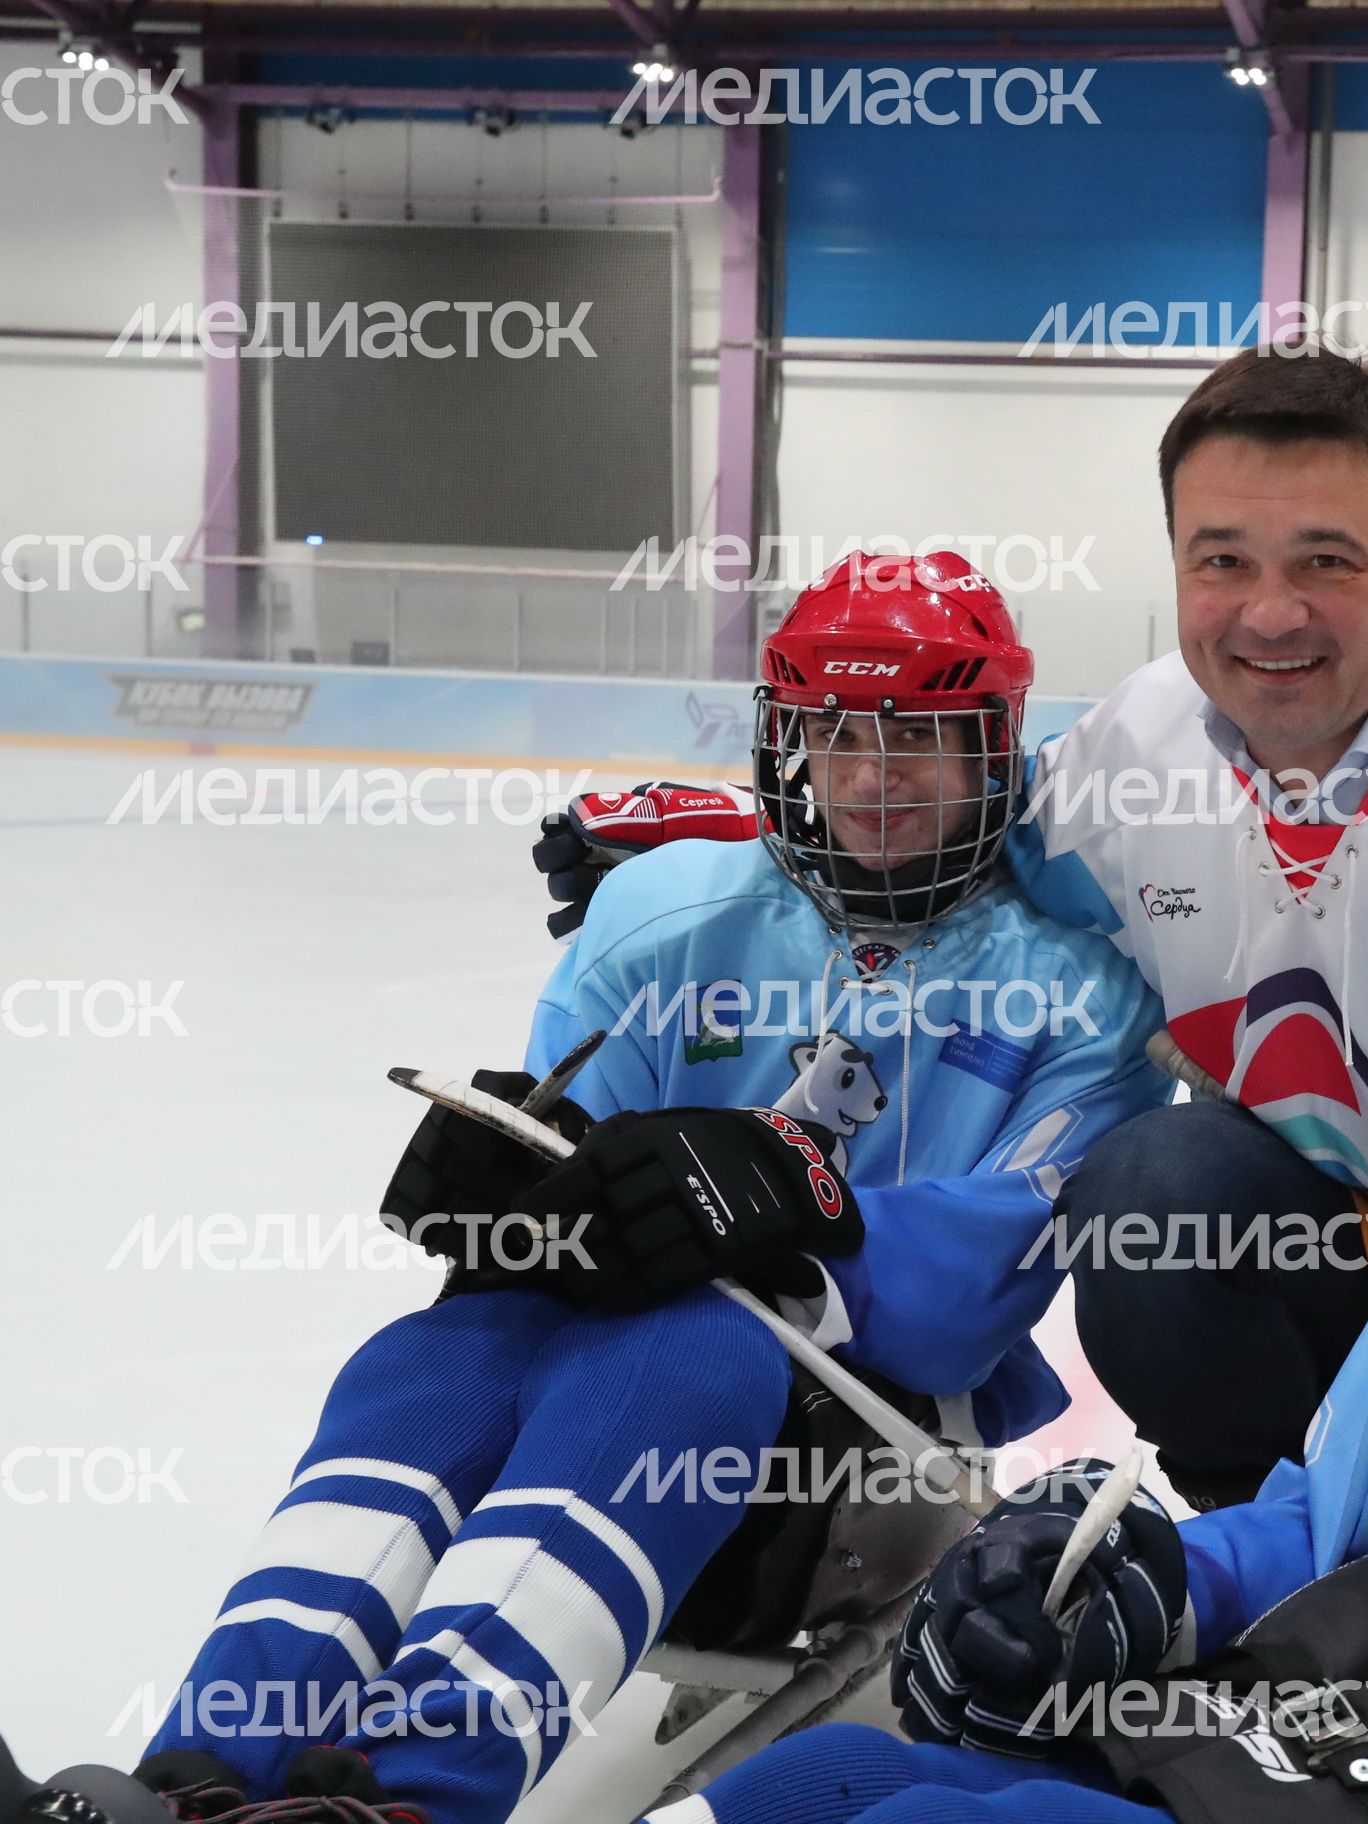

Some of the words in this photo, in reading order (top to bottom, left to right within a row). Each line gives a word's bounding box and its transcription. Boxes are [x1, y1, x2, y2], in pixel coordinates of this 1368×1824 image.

[823, 661, 901, 677] CCM
[678, 797, 724, 808] Сергей
[1150, 896, 1202, 920] Сердца
